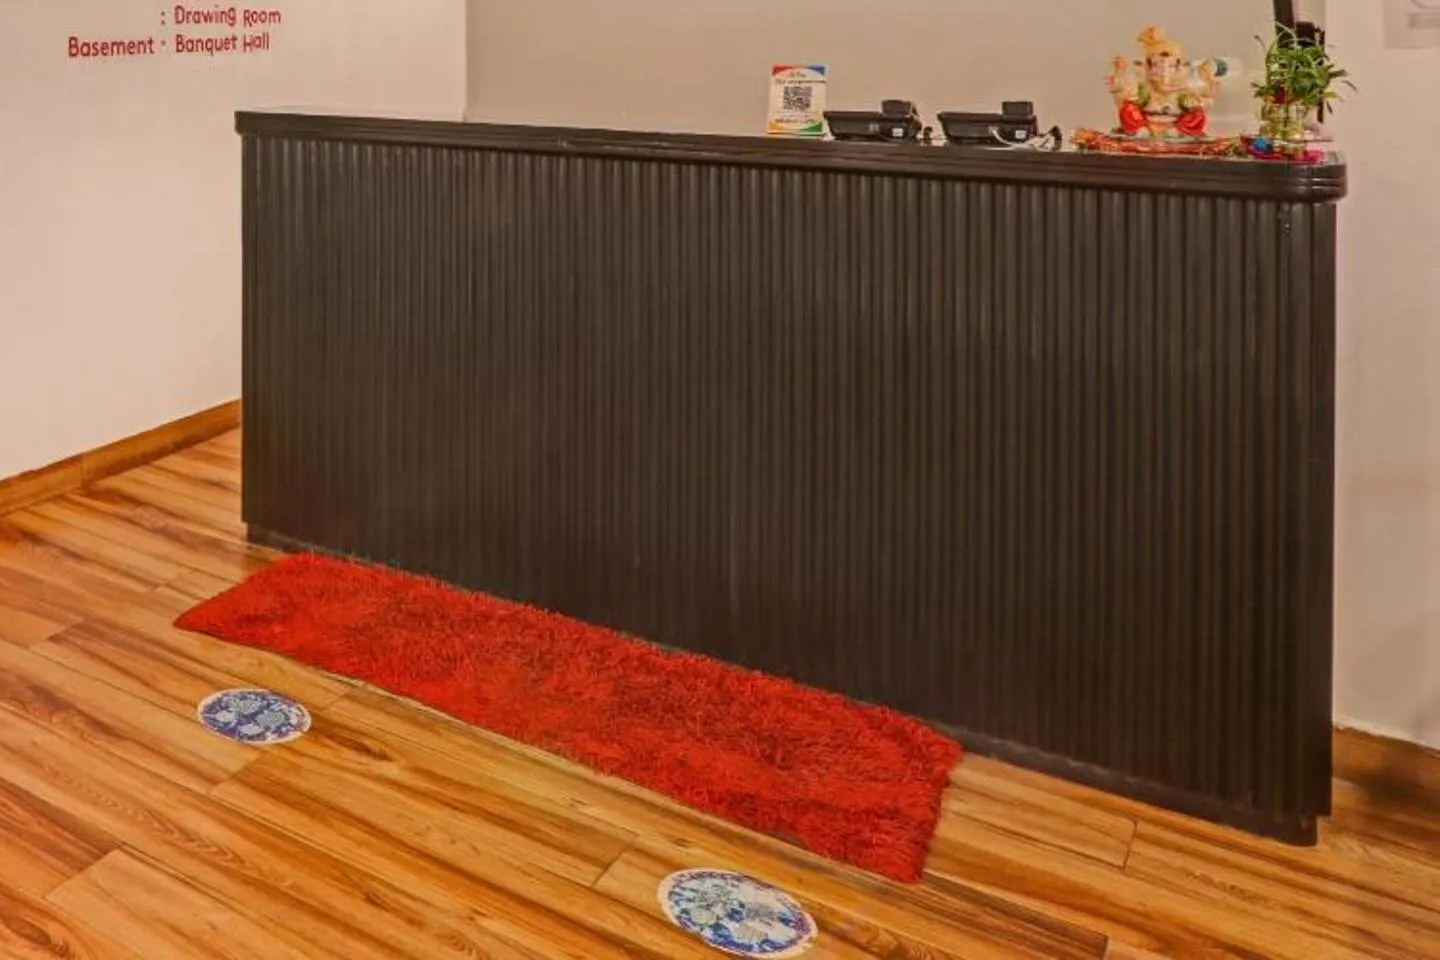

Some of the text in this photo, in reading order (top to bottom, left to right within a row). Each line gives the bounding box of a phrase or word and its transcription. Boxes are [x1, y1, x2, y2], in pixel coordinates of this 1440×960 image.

[174, 4, 237, 27] Drawing
[242, 8, 282, 28] Room
[68, 36, 155, 58] Basement
[175, 33, 239, 57] Banquet
